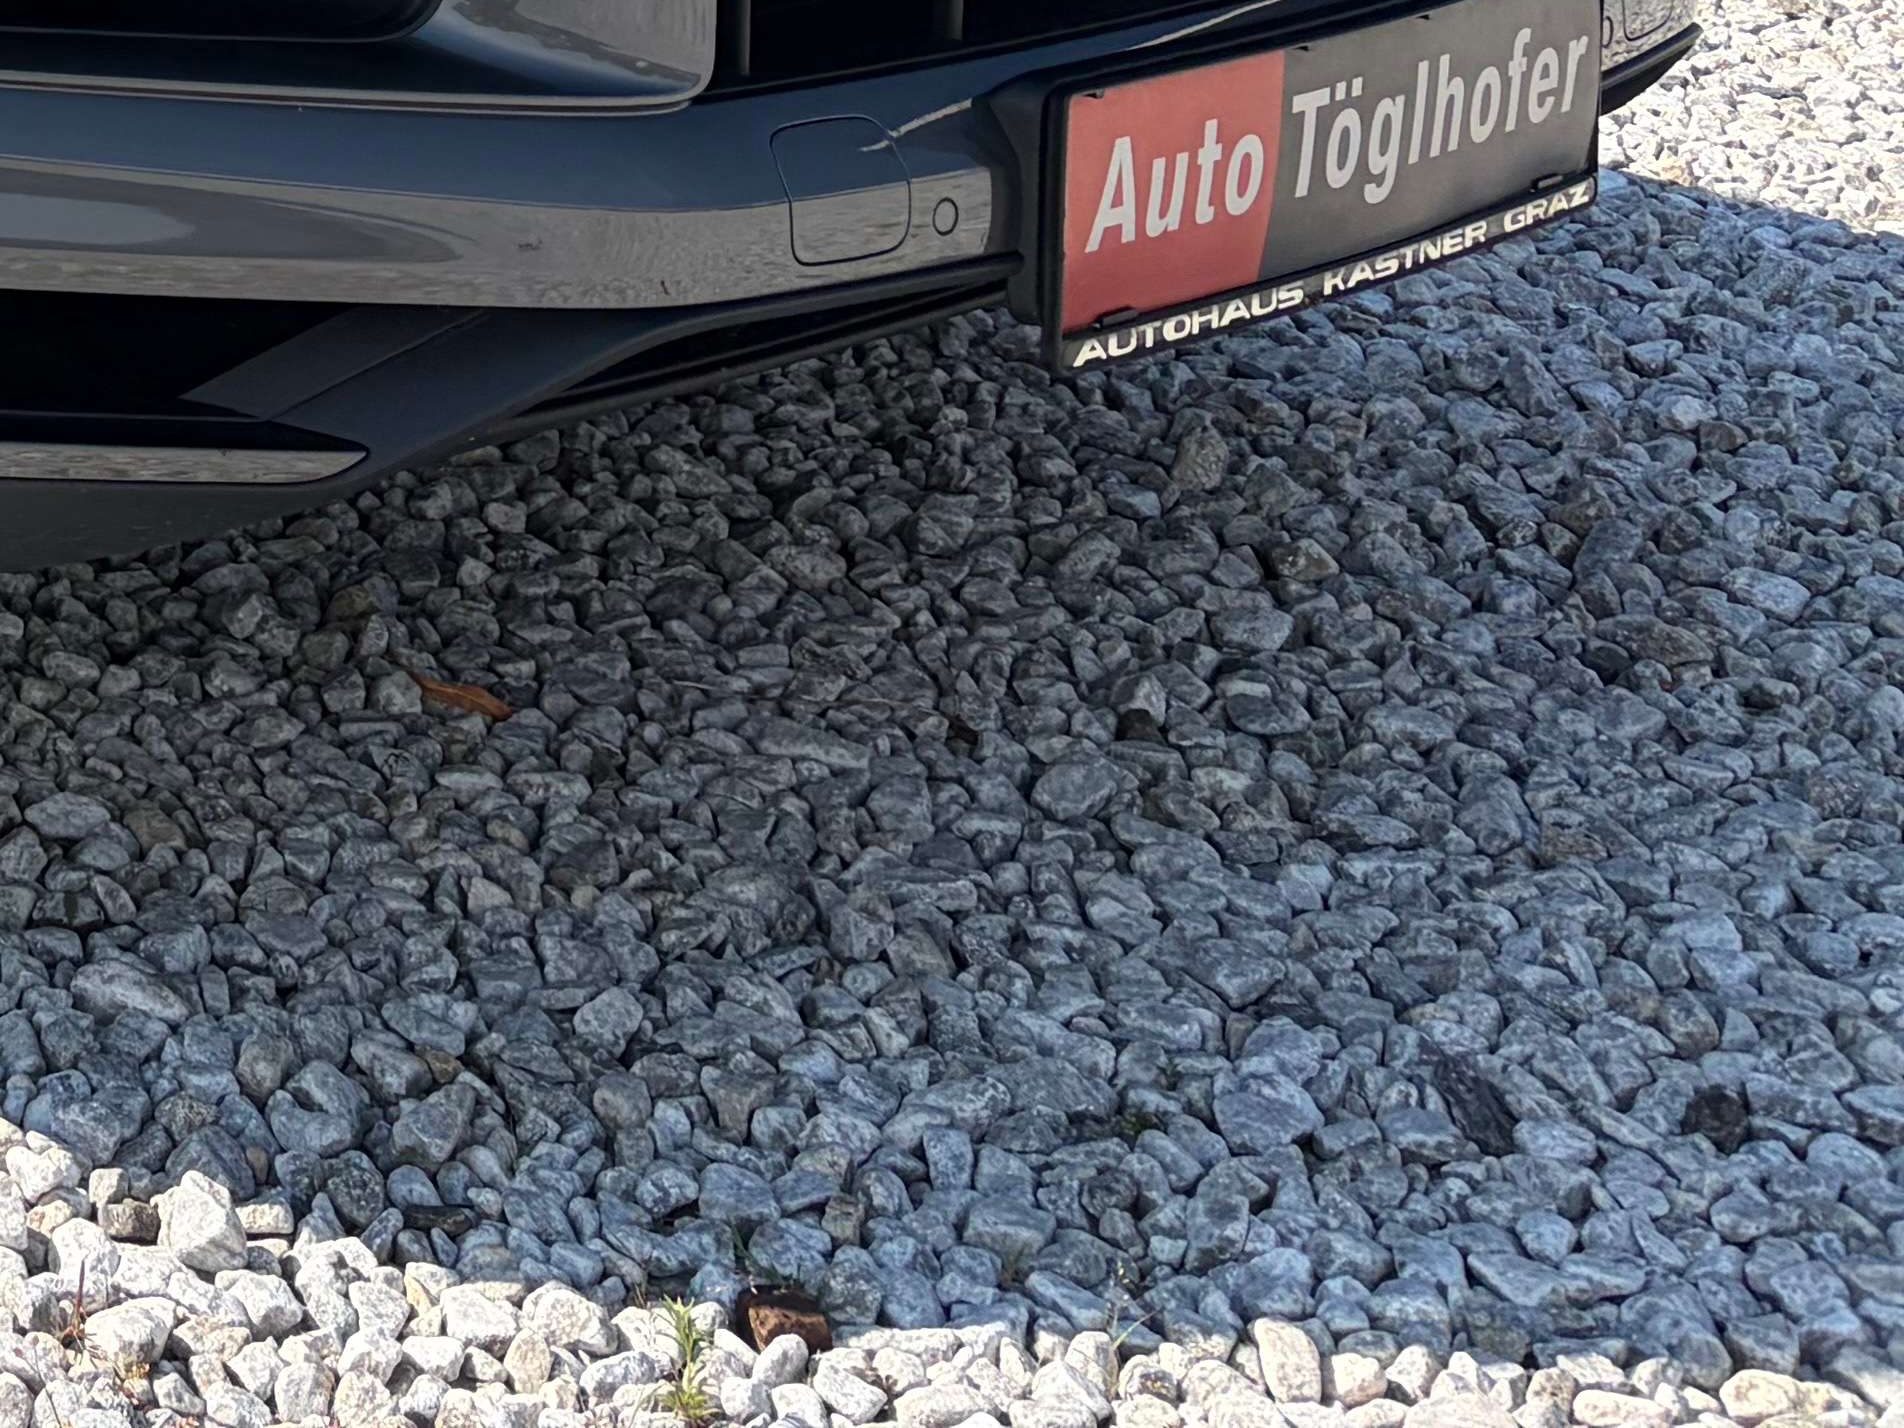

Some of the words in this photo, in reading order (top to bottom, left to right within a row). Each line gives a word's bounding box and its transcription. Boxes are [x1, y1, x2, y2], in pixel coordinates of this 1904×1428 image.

[1083, 118, 1264, 253] Auto
[1293, 27, 1589, 204] Töglhofer
[1072, 286, 1304, 368] AUTOHAUS
[1323, 220, 1489, 299] KASTNER
[1503, 181, 1591, 234] GRAZ
